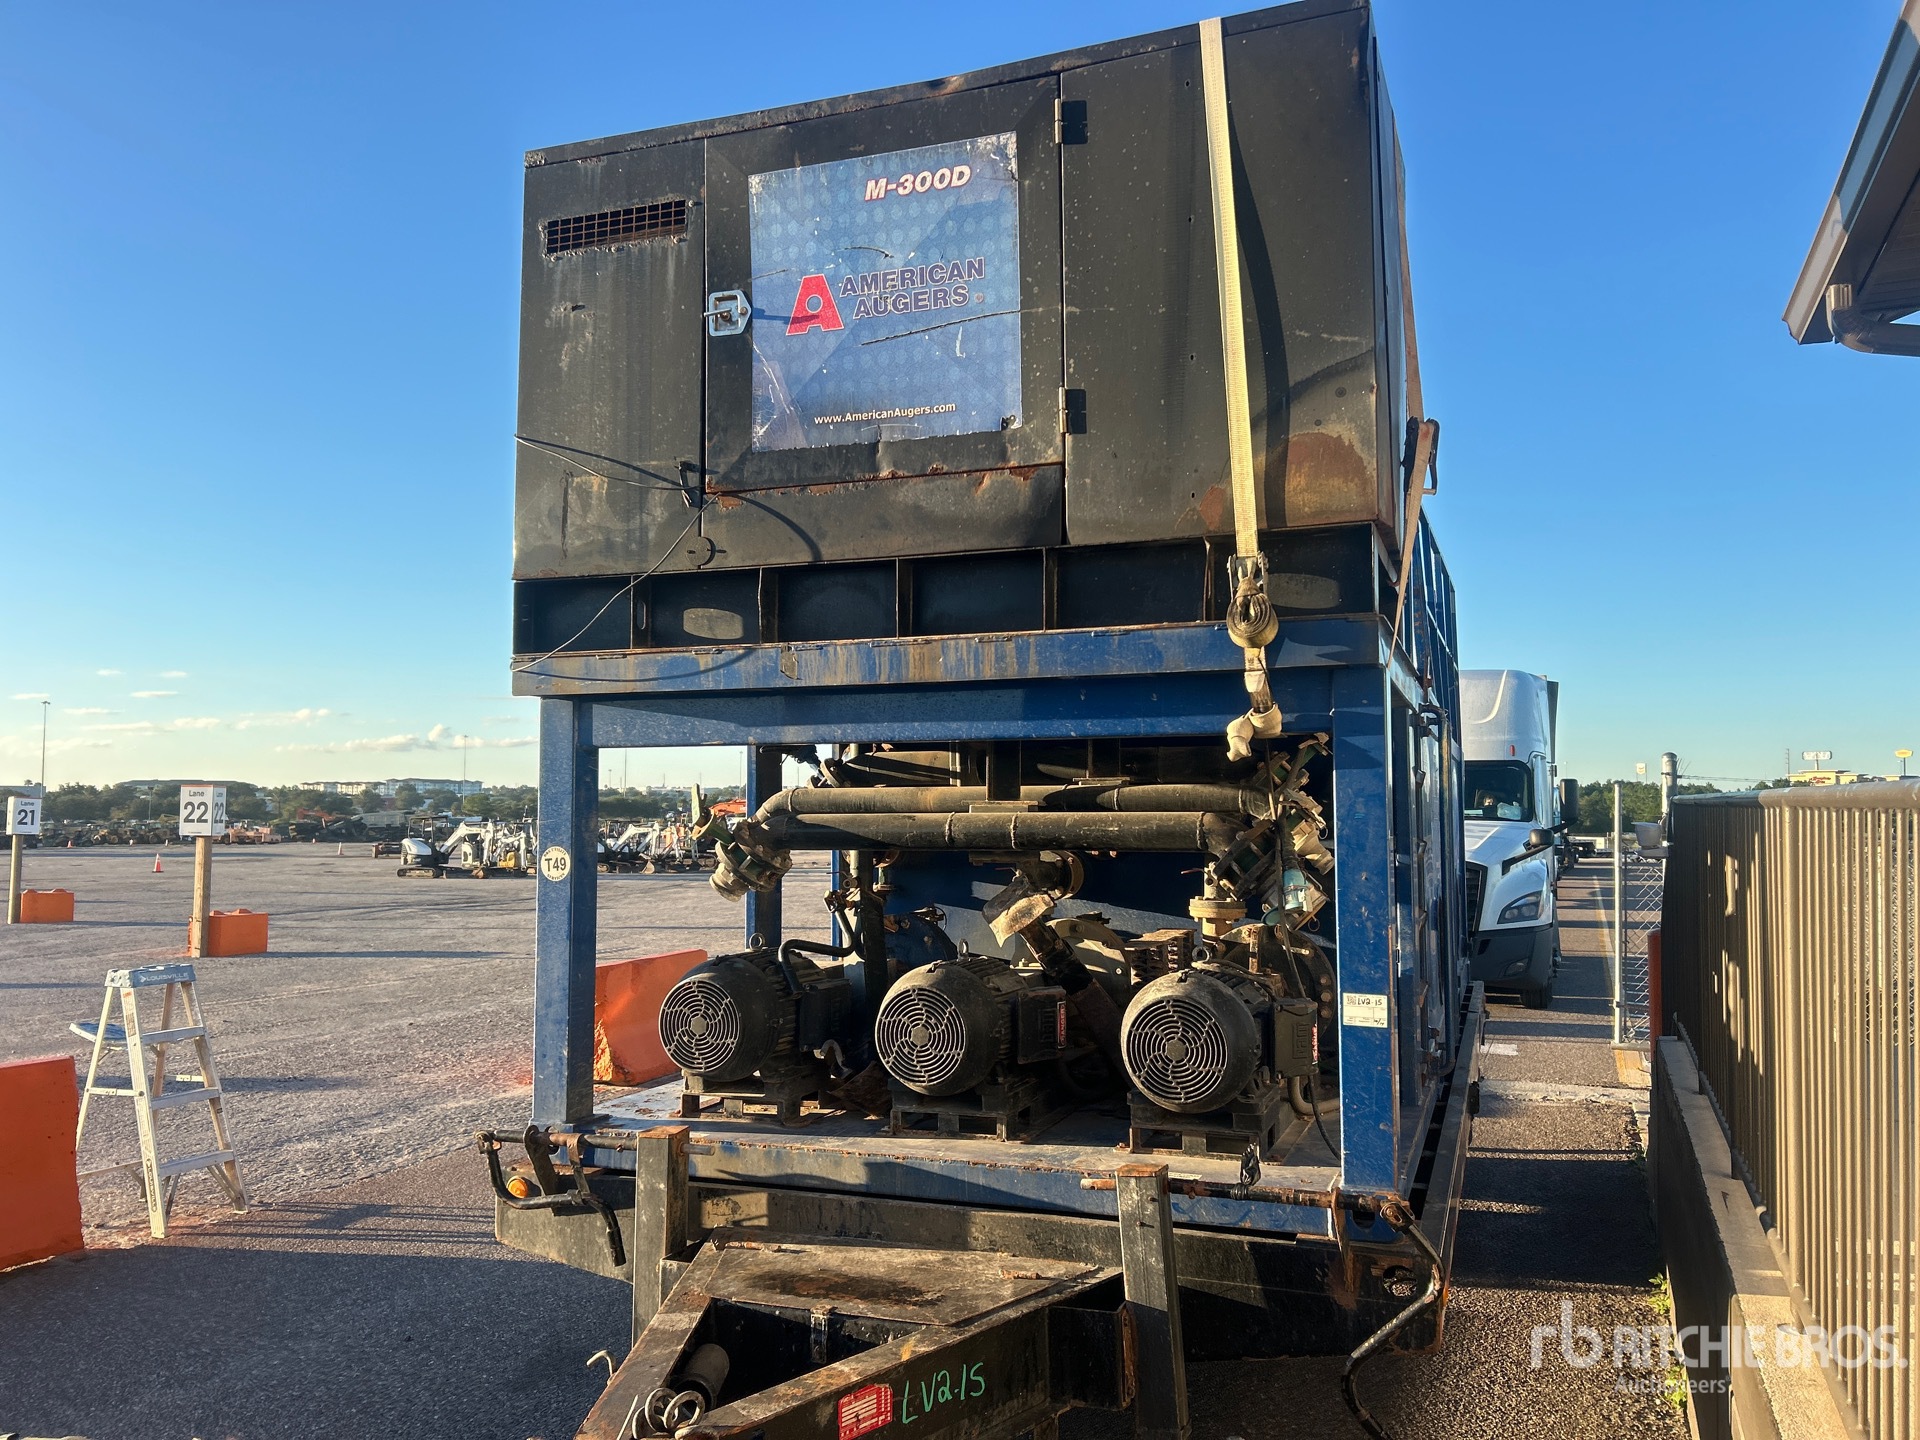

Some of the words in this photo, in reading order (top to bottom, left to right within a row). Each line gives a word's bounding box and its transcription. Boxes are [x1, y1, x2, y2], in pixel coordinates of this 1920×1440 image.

[864, 164, 972, 201] M-300D
[840, 257, 985, 297] AMERICAN
[853, 285, 969, 319] AUGERS
[814, 402, 956, 425] www.AmericanAugers.com
[17, 809, 36, 826] 21
[183, 801, 209, 823] 22
[214, 802, 225, 824] 22
[544, 857, 567, 872] T49
[146, 972, 189, 981] LOUISVILLE
